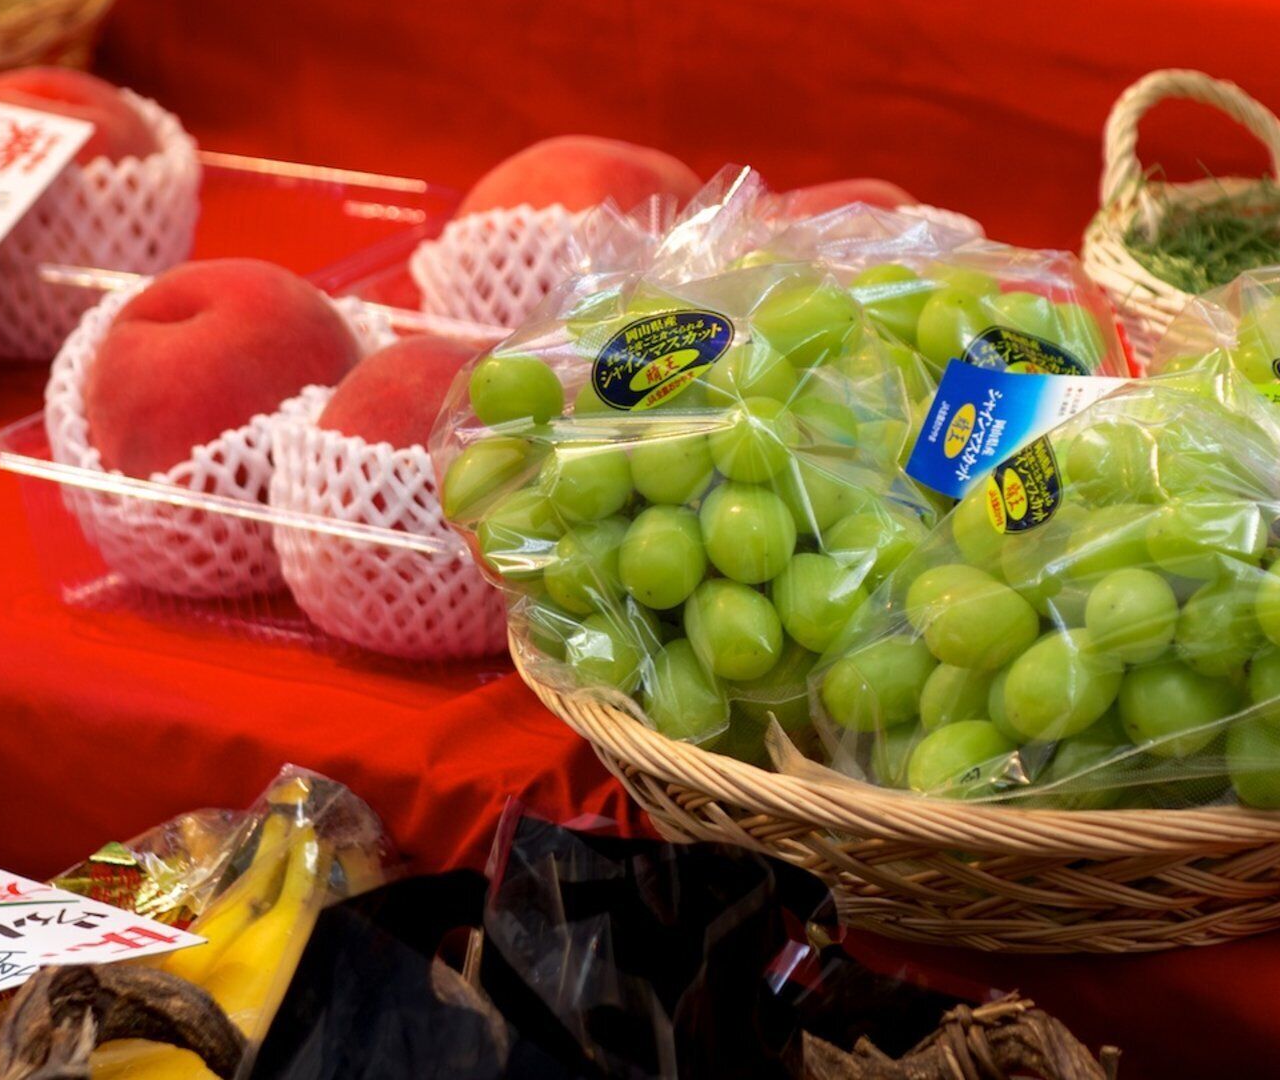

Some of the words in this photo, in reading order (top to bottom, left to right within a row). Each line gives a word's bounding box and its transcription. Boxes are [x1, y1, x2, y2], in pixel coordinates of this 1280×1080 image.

[601, 323, 722, 388] シャインマスカット
[625, 315, 677, 341] 岡山県産
[955, 388, 1003, 481] シャインマスカット
